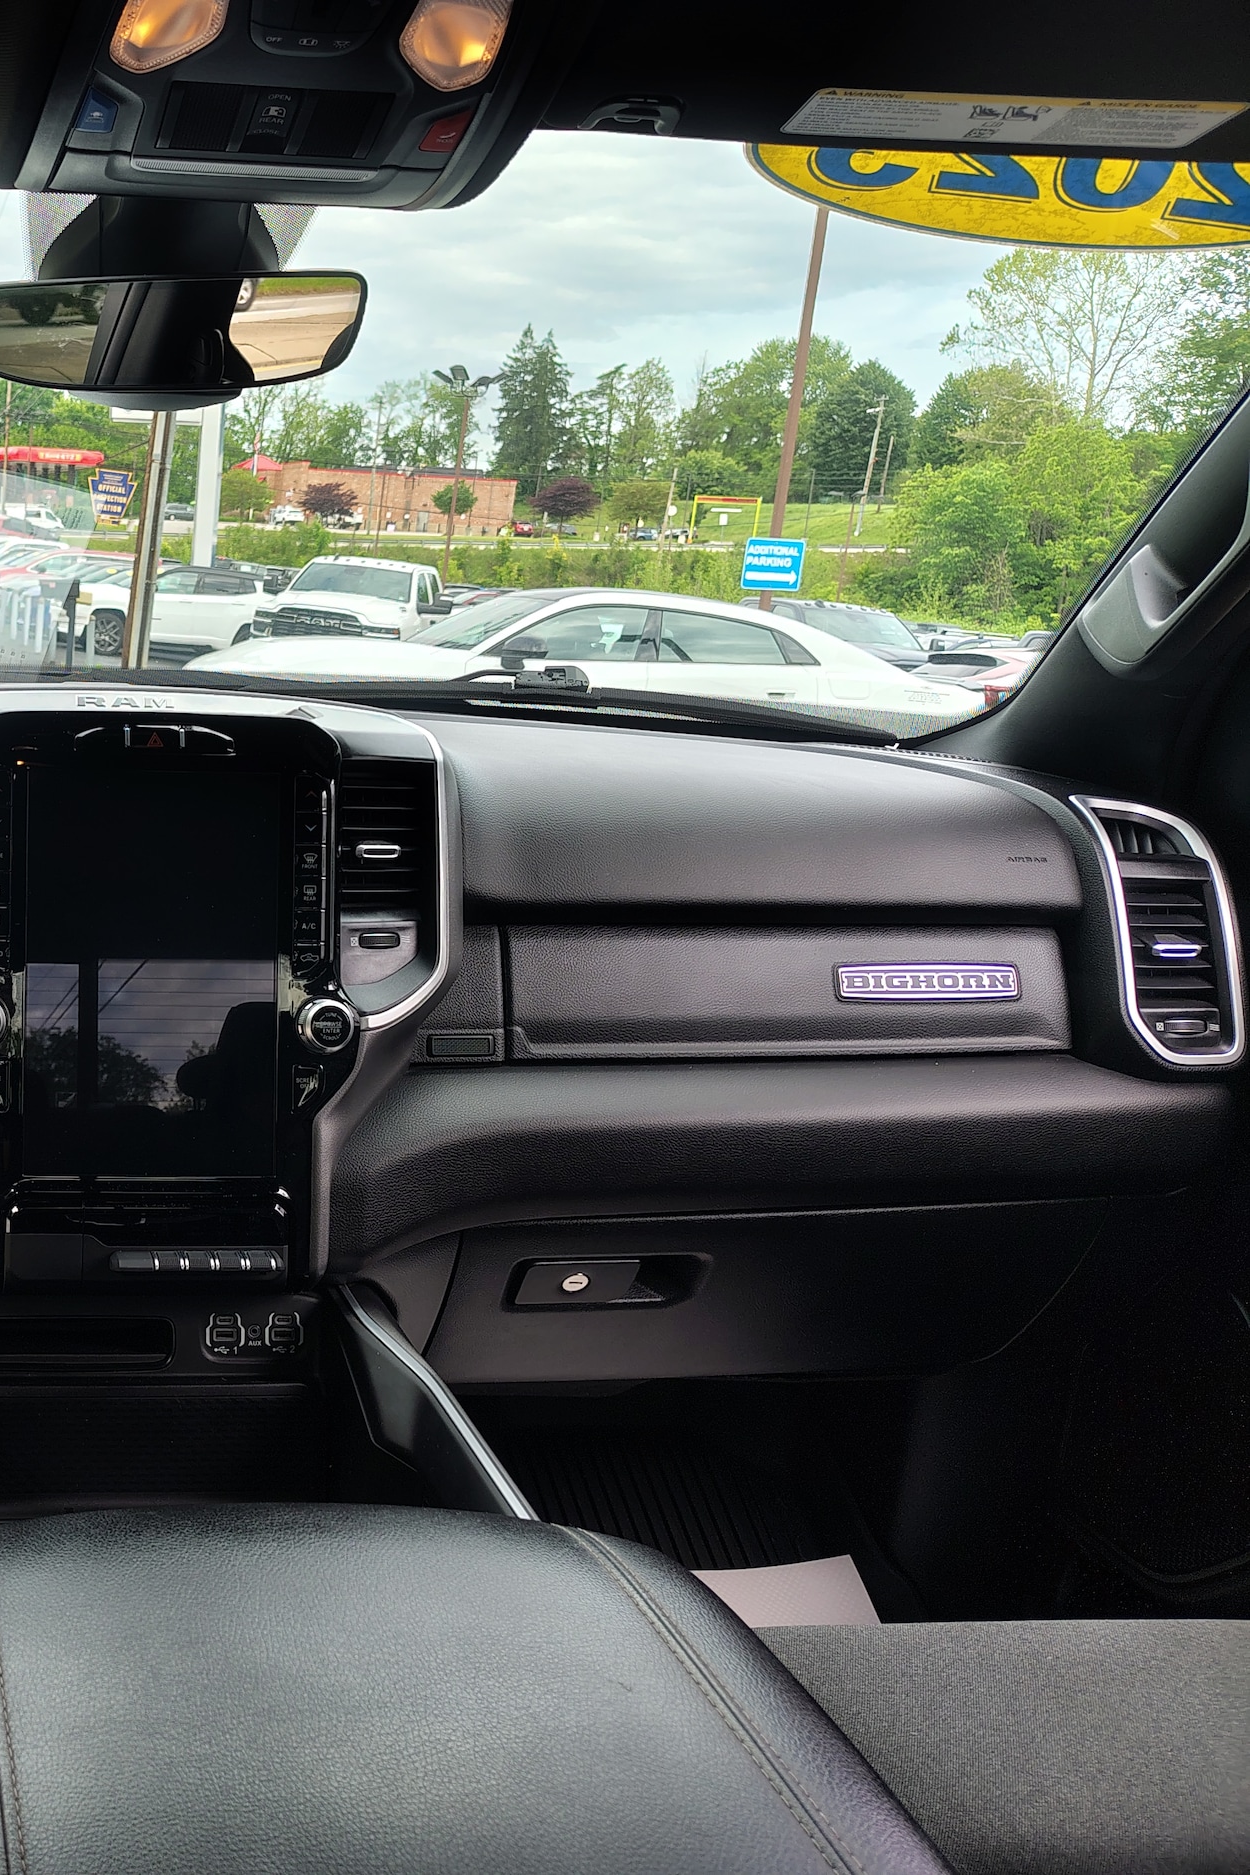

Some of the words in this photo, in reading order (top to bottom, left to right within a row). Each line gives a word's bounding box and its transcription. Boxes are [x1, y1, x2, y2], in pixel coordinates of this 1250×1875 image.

[268, 93, 291, 102] OPEN
[843, 91, 905, 99] WARNING
[258, 116, 284, 125] REAR
[97, 484, 126, 494] OFFICIAL
[96, 503, 123, 513] STATION
[747, 544, 800, 556] ADDITIONAL
[745, 555, 793, 568] PARKING
[77, 695, 175, 709] RAM
[844, 974, 1012, 989] BIGHORN
[232, 1346, 238, 1355] 1
[290, 1345, 296, 1354] 2
